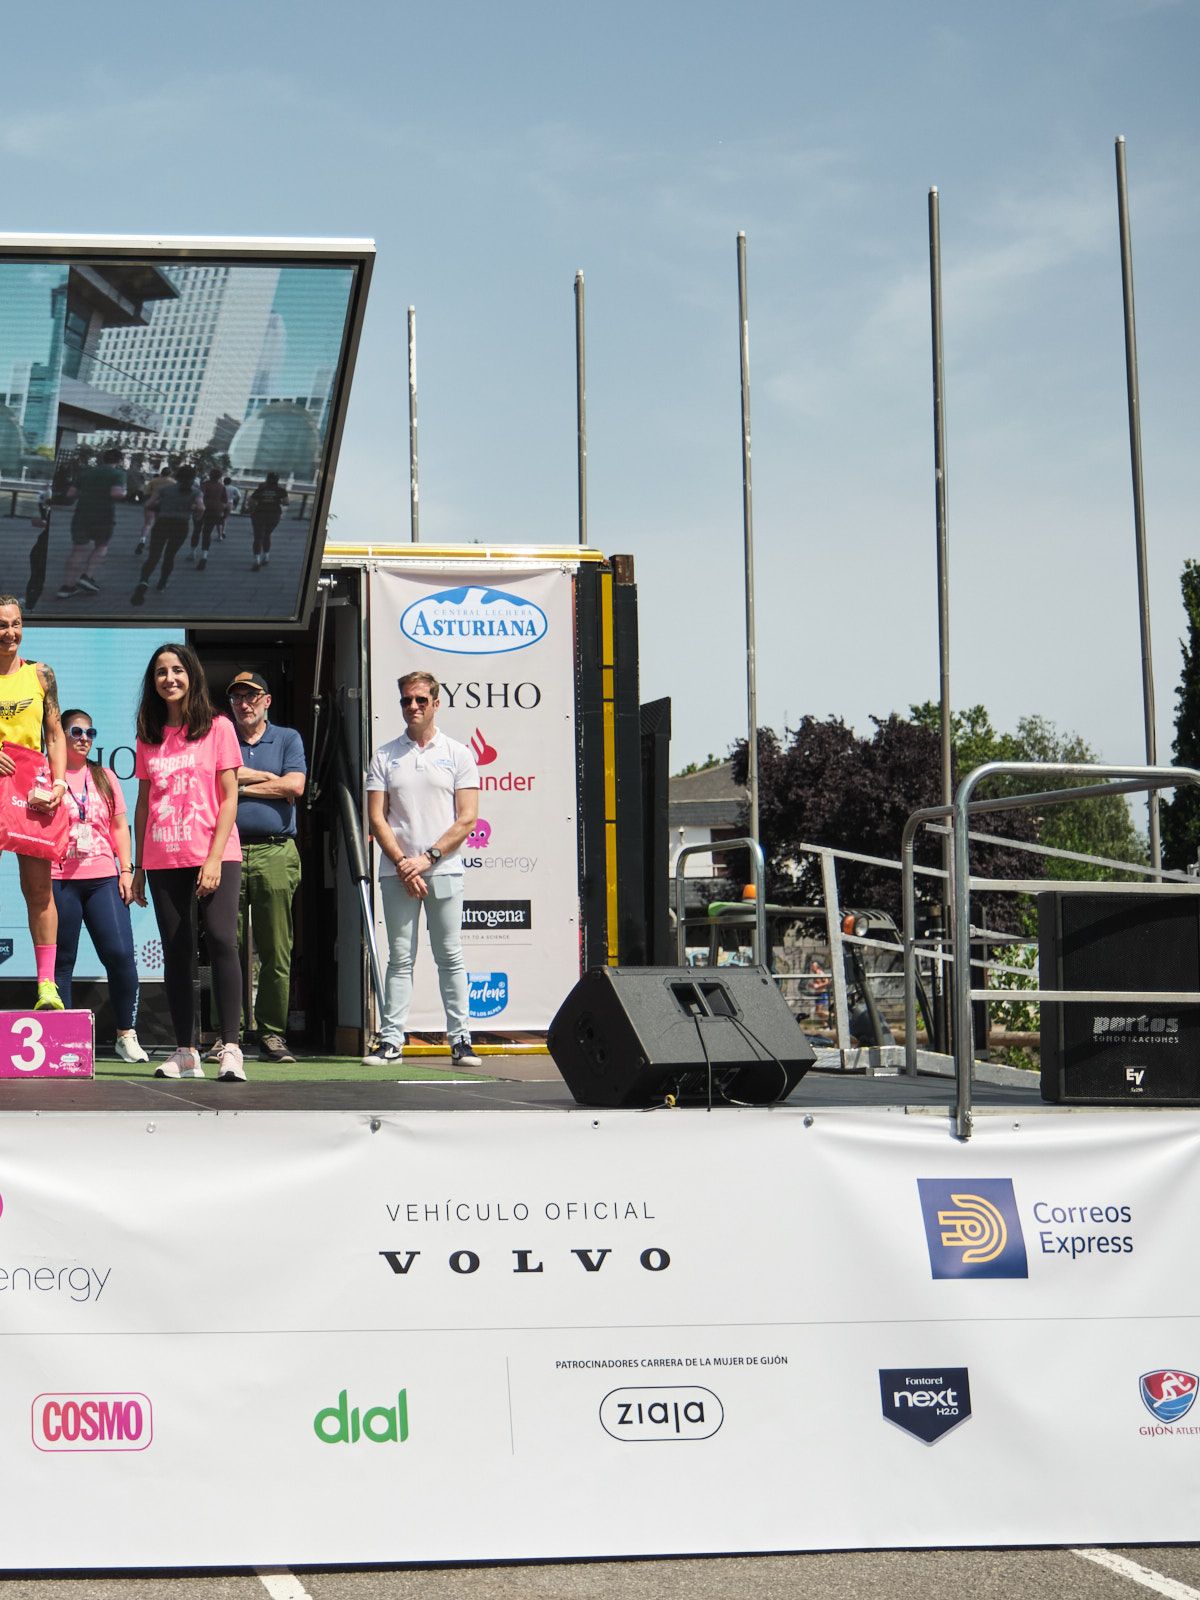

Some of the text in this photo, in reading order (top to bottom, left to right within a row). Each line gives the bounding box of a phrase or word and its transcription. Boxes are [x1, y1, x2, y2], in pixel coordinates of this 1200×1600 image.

[412, 610, 538, 637] ASTURIANA
[485, 857, 539, 873] energy
[10, 1017, 46, 1072] 3
[386, 1200, 656, 1222] VEHÍCULO OFICIAL
[1033, 1202, 1131, 1224] Correos
[1040, 1231, 1133, 1259] Express
[379, 1247, 671, 1275] VOLVO
[555, 1354, 788, 1369] PATROCINADORES CARRERA DE LA MUJER DE GIJÓN
[905, 1376, 943, 1385] Fontarel
[893, 1387, 958, 1407] next
[42, 1400, 143, 1442] COSMO
[313, 1389, 409, 1444] dial
[617, 1401, 705, 1433] ziaja
[1139, 1423, 1174, 1437] GIJÓN
